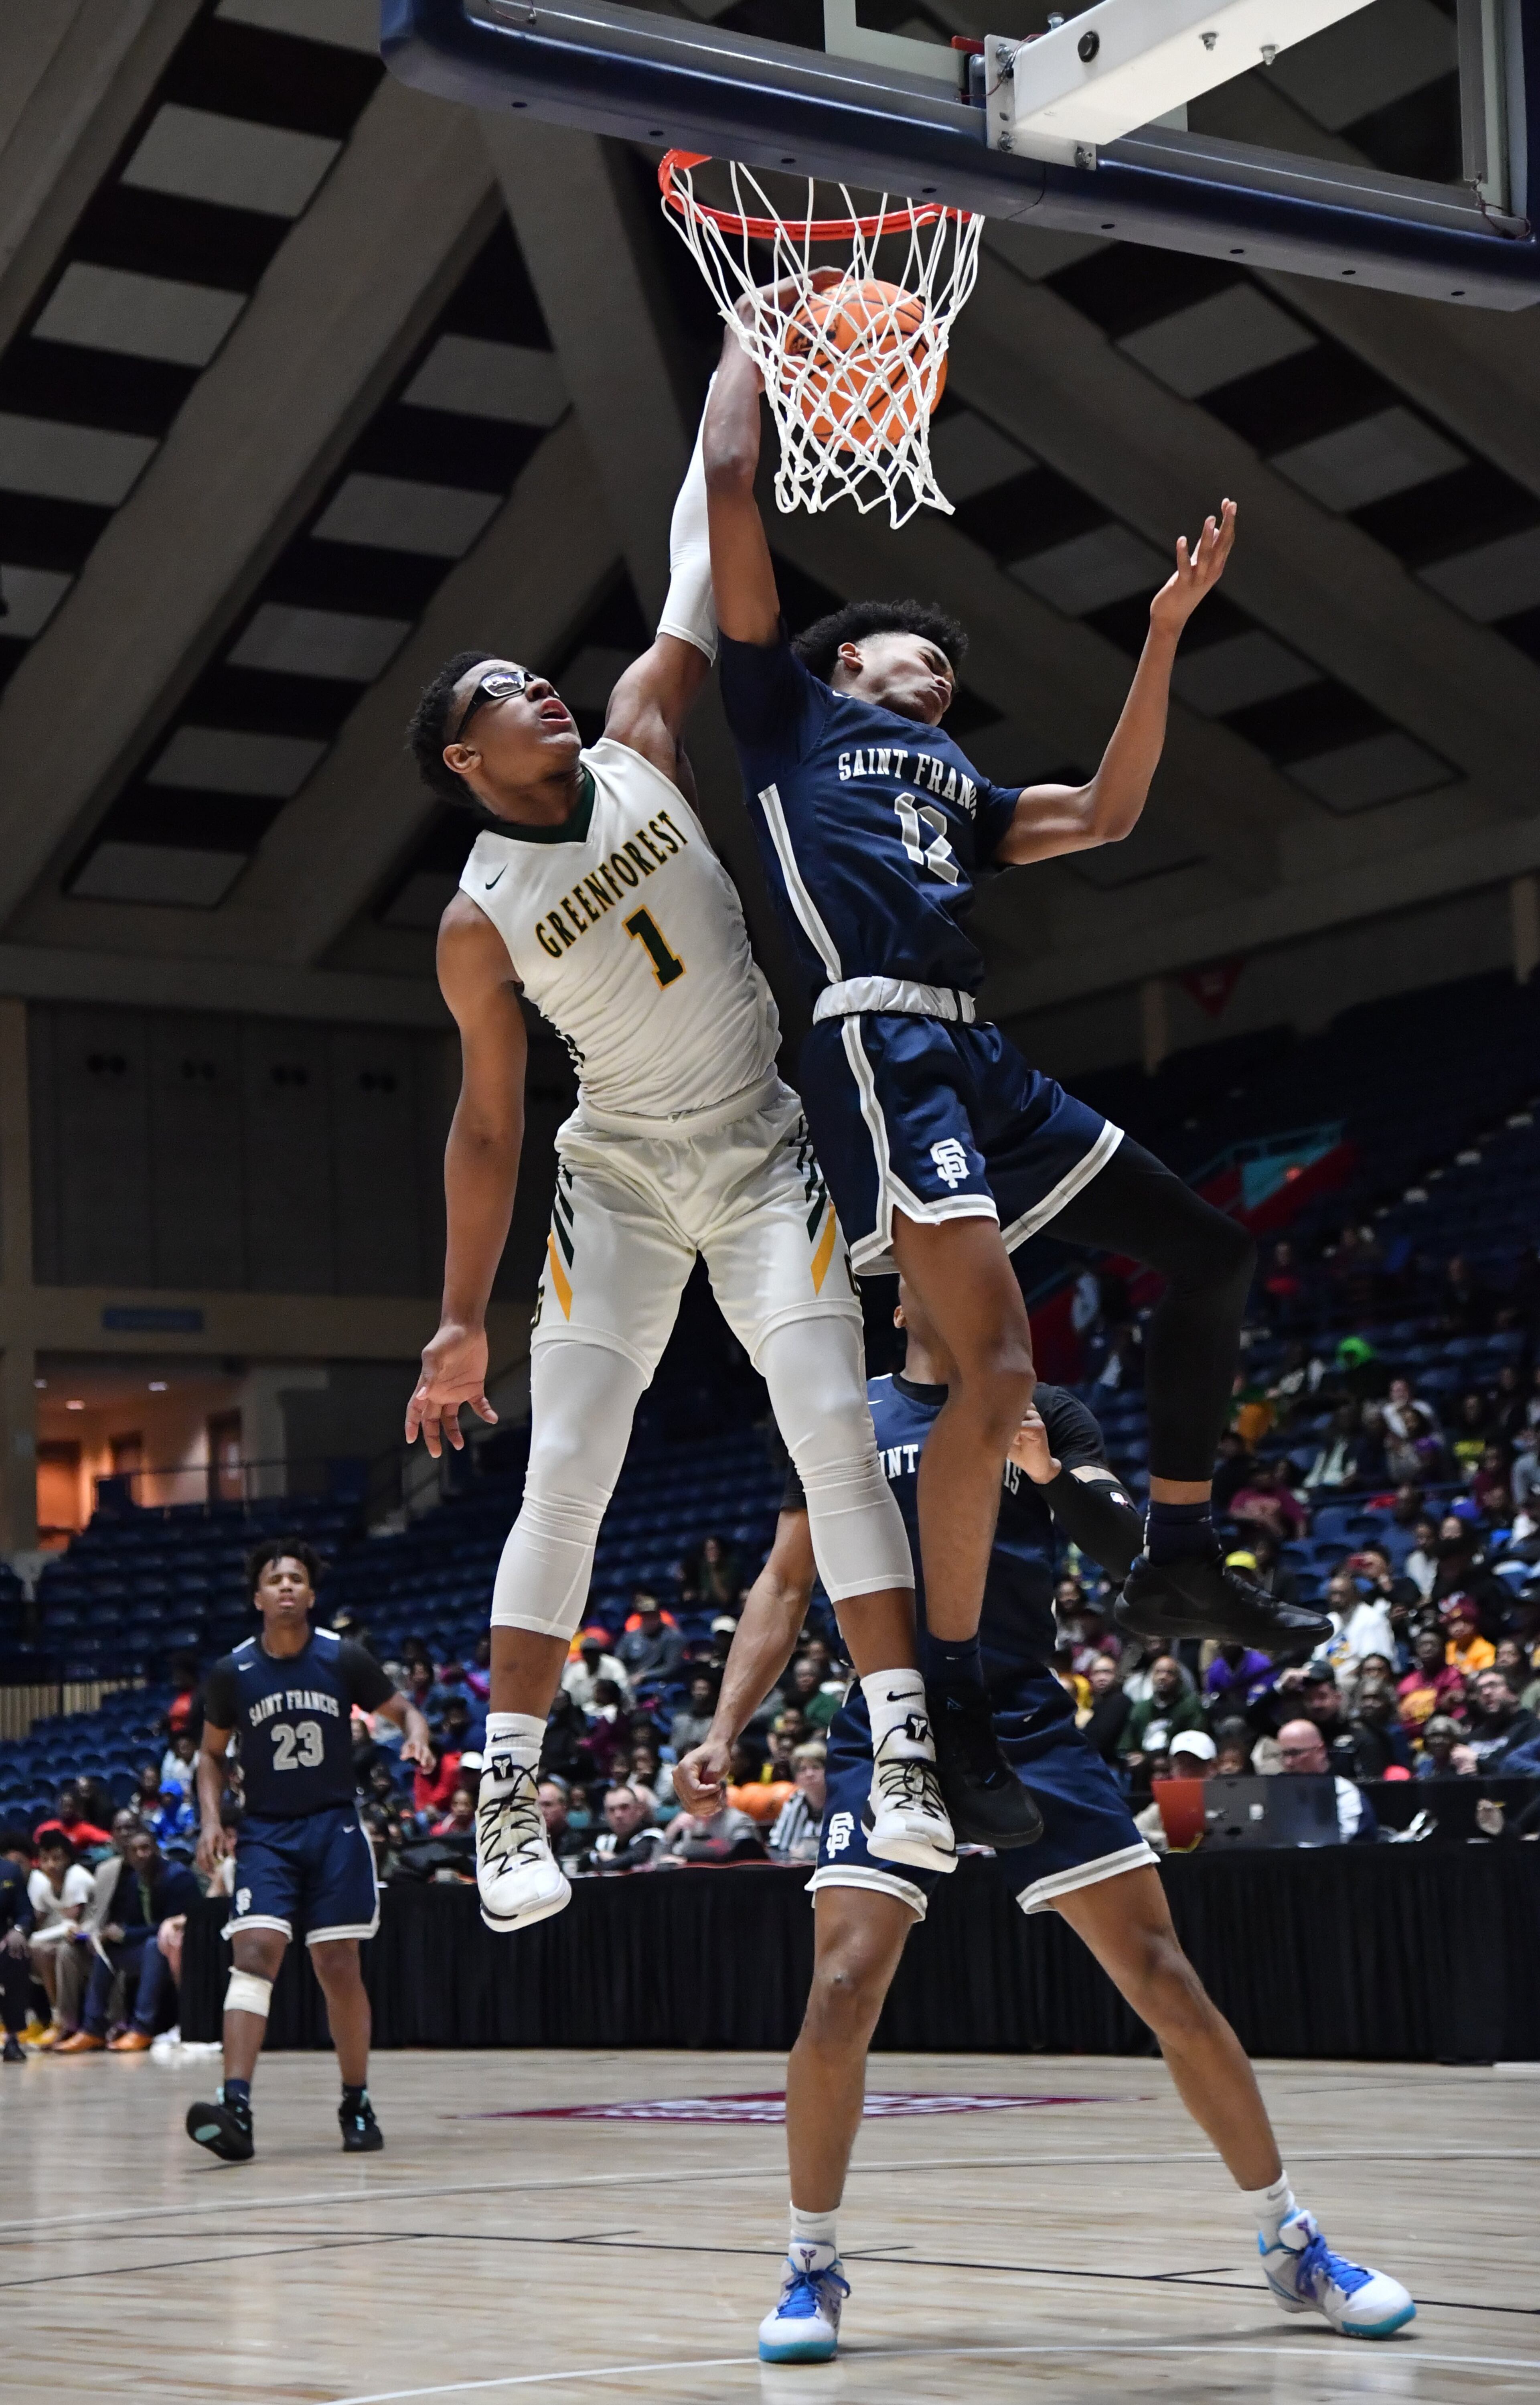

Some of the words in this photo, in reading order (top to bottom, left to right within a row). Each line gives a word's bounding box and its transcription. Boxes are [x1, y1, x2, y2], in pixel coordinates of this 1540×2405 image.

[839, 748, 908, 781] SAINT
[914, 753, 977, 820] FRAN
[895, 792, 958, 887] 12
[535, 810, 688, 958] GREENFOREST
[621, 904, 687, 991] 1
[878, 1444, 919, 1479] INT
[249, 1692, 283, 1727] SAINT
[286, 1689, 340, 1717] FRANCIS
[270, 1720, 324, 1771] 23
